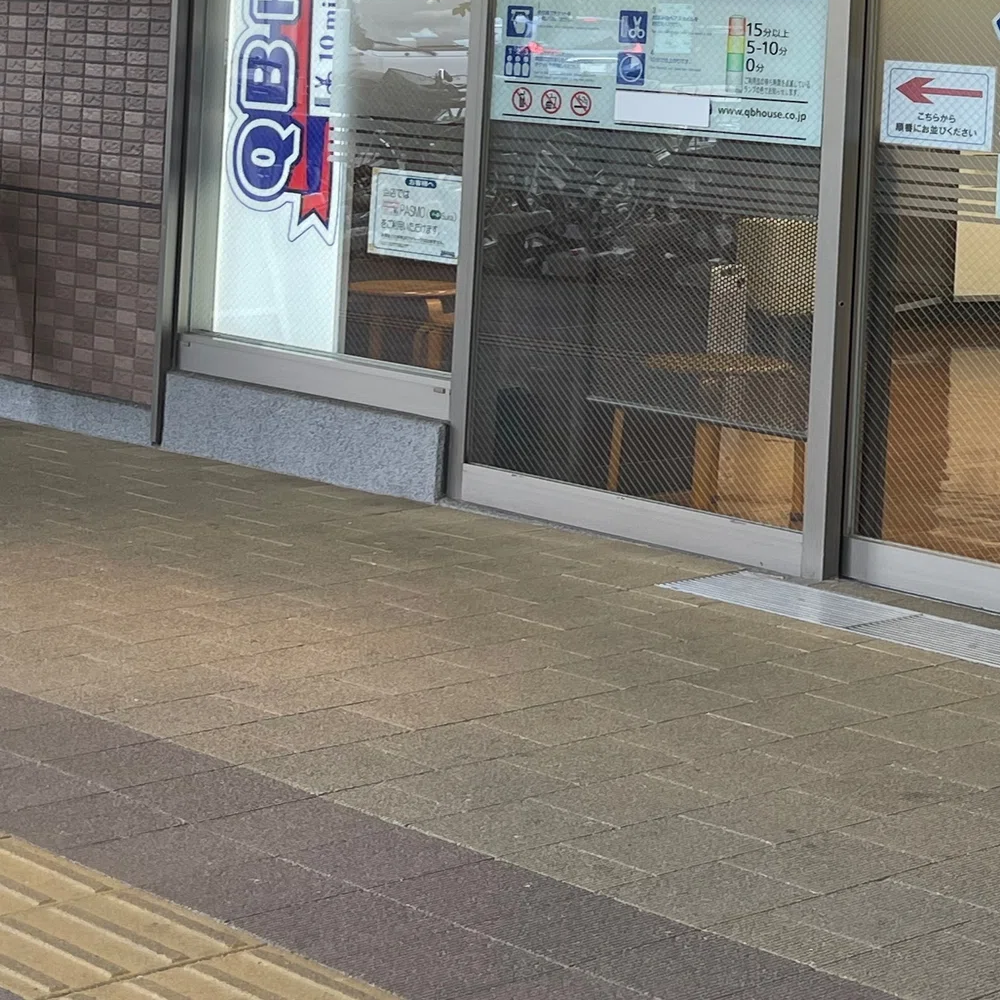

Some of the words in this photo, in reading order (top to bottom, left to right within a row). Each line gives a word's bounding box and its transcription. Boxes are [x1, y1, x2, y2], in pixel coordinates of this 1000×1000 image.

[746, 22, 790, 38] 15分以上
[319, 34, 334, 61] 10
[746, 40, 788, 56] 5-10分
[745, 58, 765, 72] 0分
[236, 38, 301, 198] QB
[718, 106, 807, 123] www.qbhouse.co.jp
[917, 112, 956, 124] こちらから
[896, 122, 978, 138] 順番にお並びください
